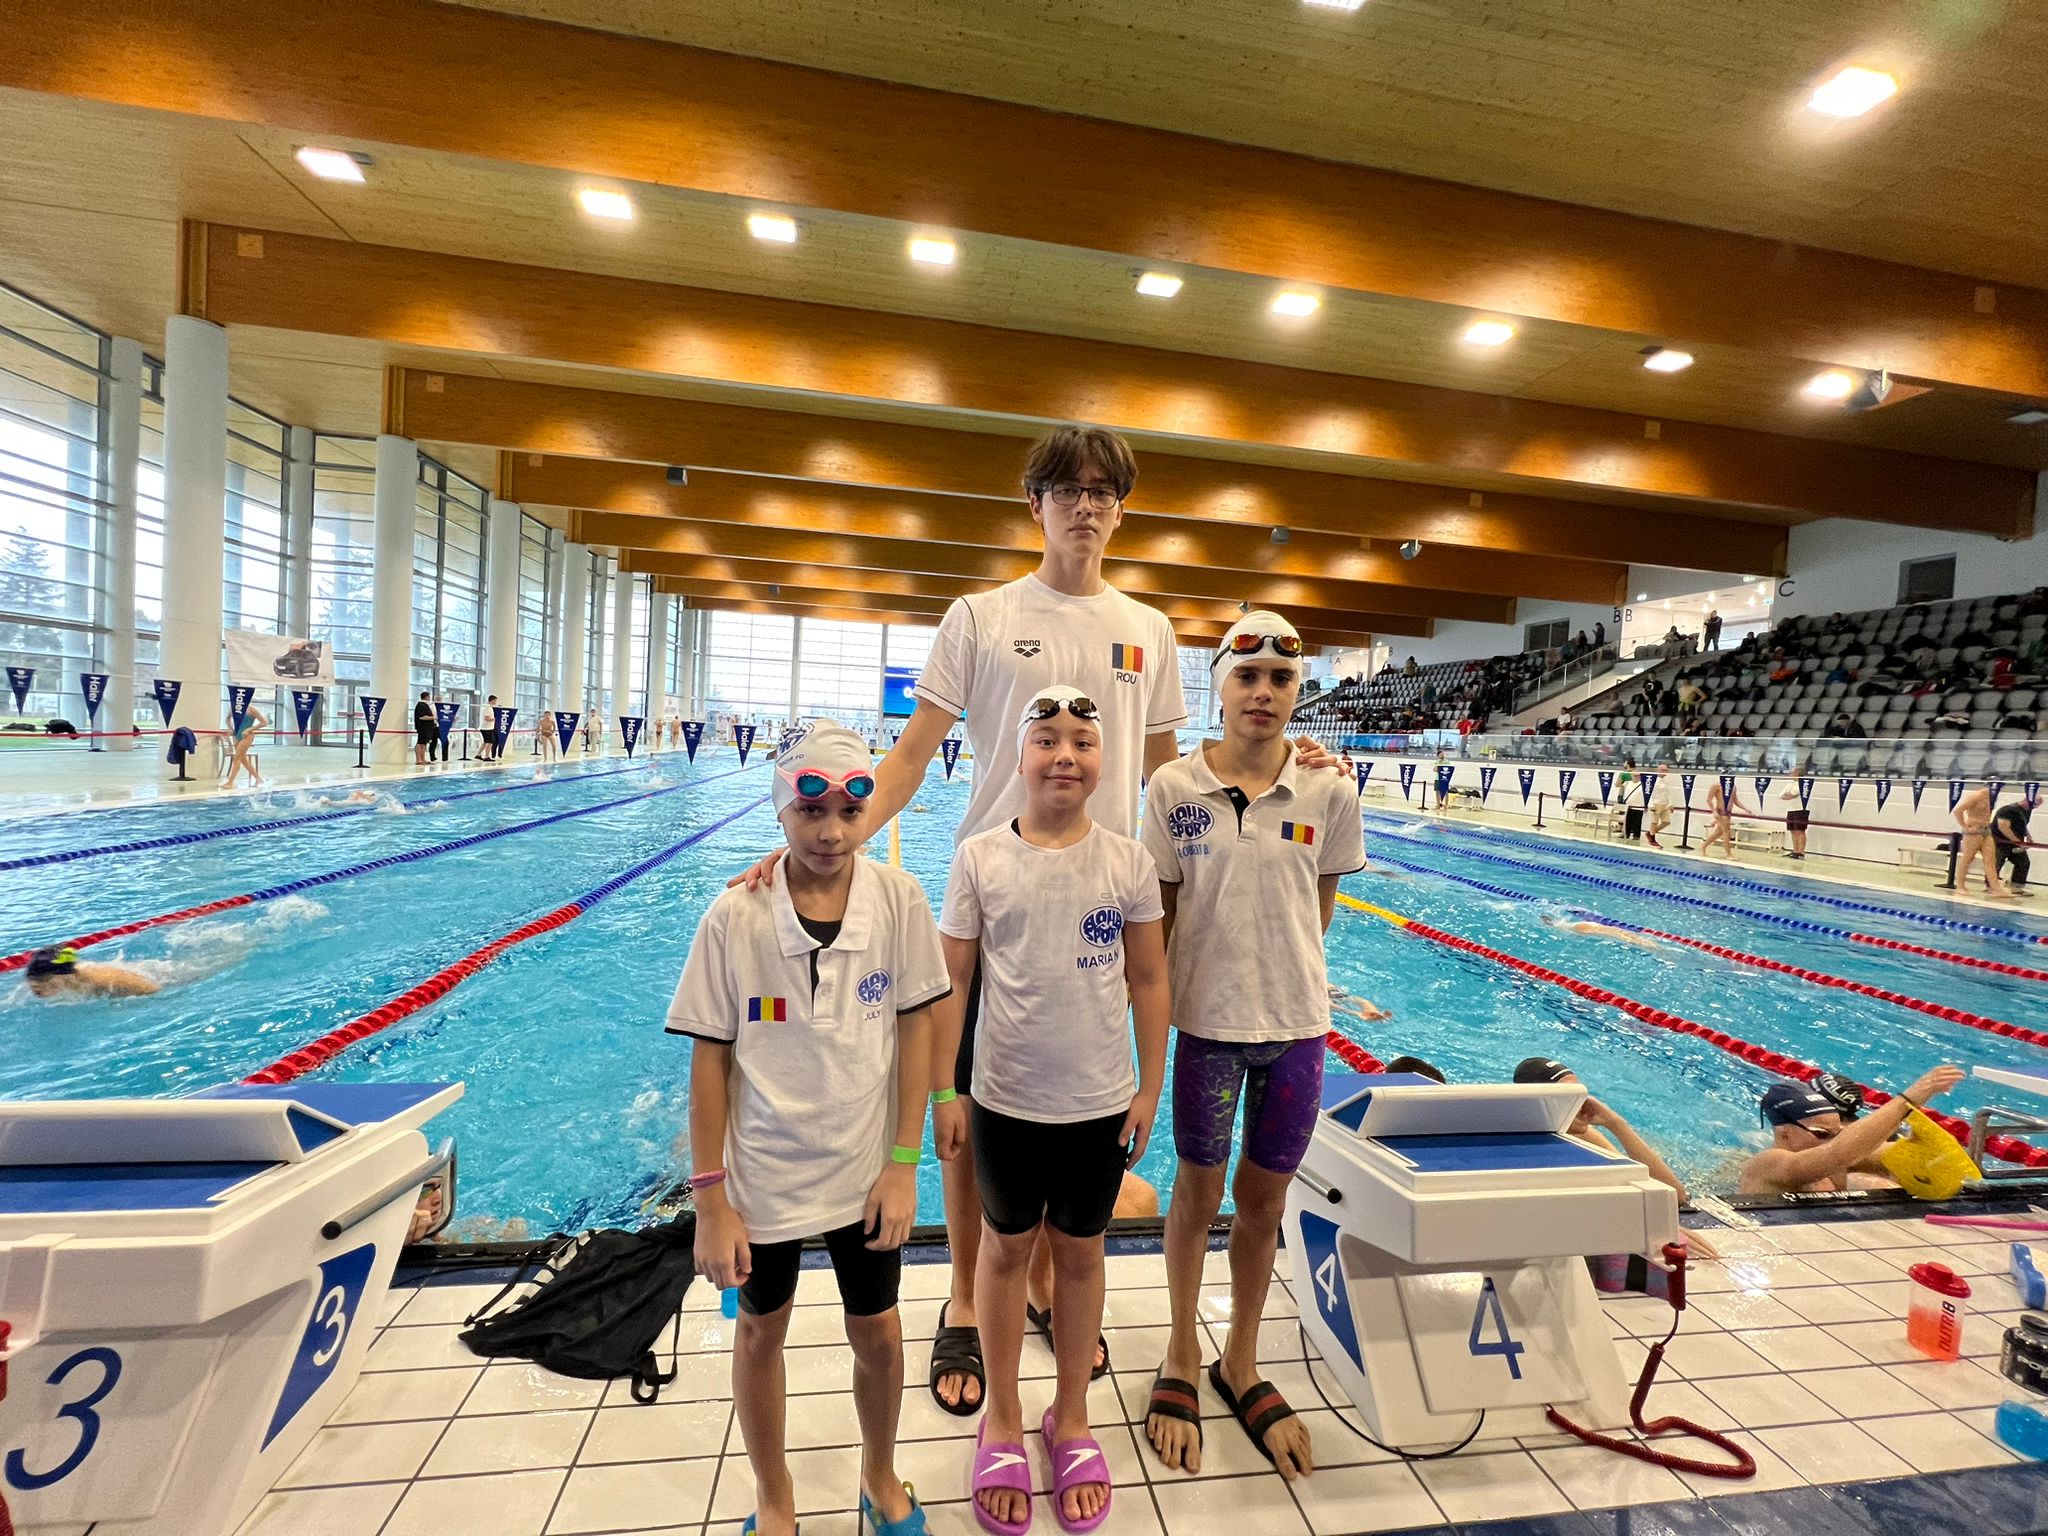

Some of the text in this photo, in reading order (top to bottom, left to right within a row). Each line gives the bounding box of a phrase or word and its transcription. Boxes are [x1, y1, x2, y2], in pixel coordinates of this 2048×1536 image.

[1778, 580, 1795, 597] C
[1613, 609, 1621, 623] B
[1013, 639, 1041, 647] arena
[90, 676, 100, 702] Haier
[1116, 671, 1137, 685] ROU
[235, 688, 246, 714] Haier
[369, 699, 378, 725] Haier
[500, 709, 510, 735] Haier
[627, 719, 635, 743] Haier
[741, 727, 750, 750] Haier
[947, 741, 955, 764] Haier
[1315, 1252, 1338, 1313] 4
[313, 1285, 347, 1367] 3
[1469, 1276, 1525, 1380] 4
[4, 1346, 123, 1491] 3
